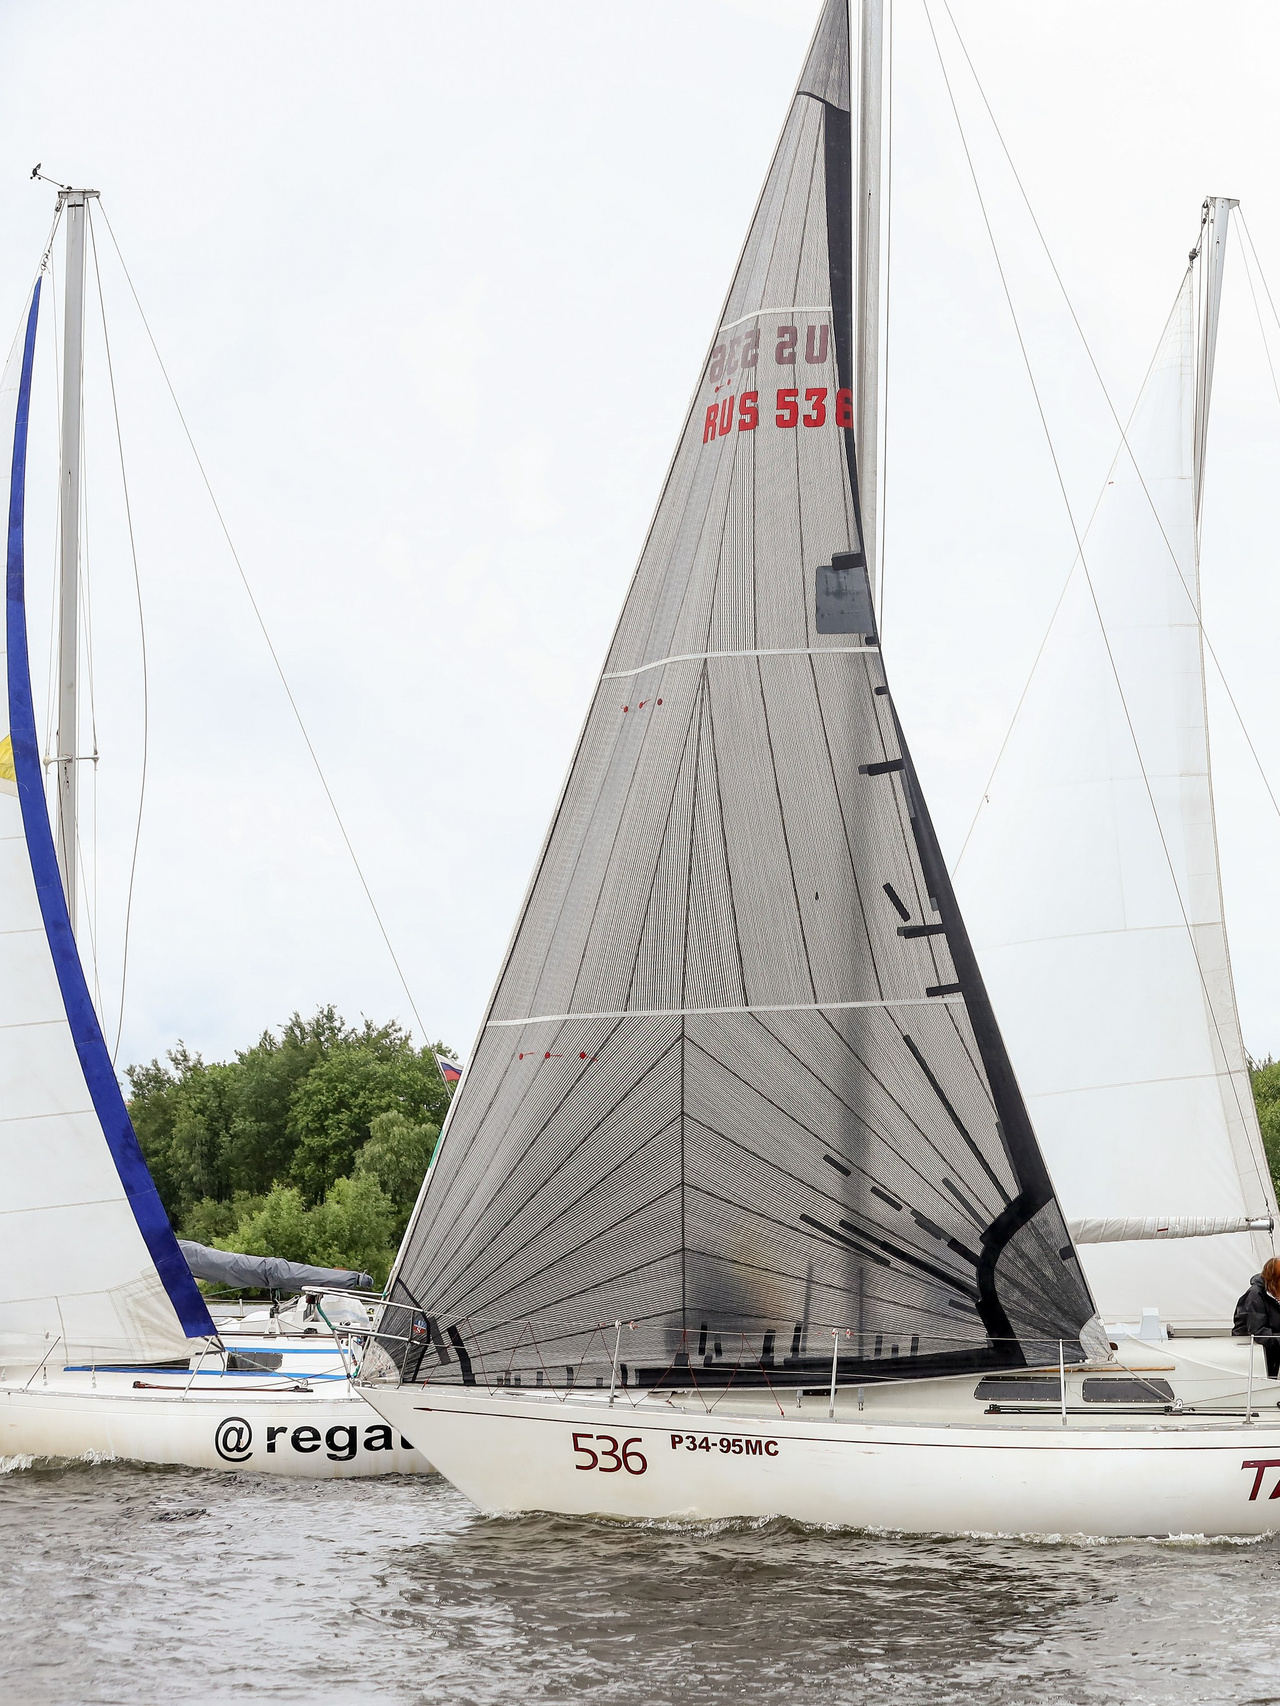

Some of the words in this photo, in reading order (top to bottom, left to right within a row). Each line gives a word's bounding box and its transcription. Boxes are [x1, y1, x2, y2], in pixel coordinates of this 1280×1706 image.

[703, 391, 759, 444] RUS
[775, 387, 854, 429] 536
[266, 1424, 414, 1462] rega
[571, 1432, 648, 1476] 536
[670, 1433, 780, 1457] Р34-95МС
